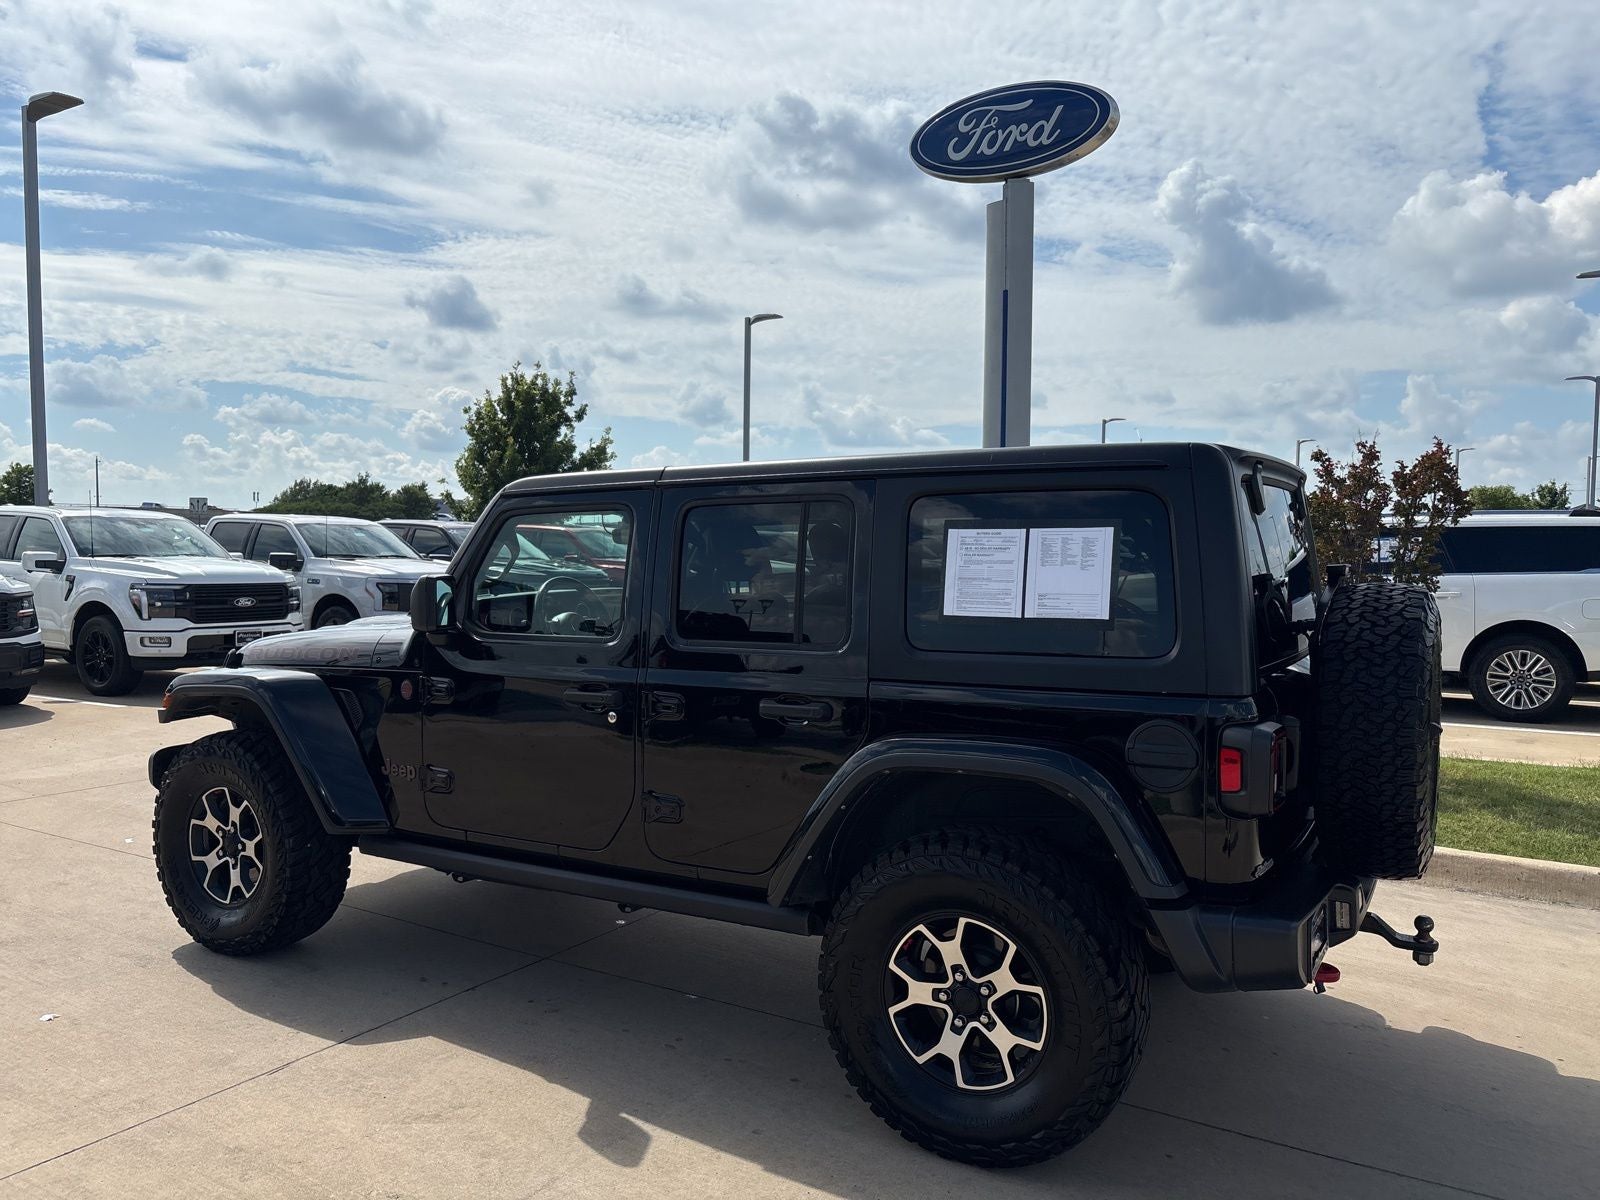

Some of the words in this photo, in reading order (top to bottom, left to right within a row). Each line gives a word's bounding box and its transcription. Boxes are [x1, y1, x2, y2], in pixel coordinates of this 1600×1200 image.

[947, 98, 1064, 161] Ford
[250, 646, 360, 661] RUBICON
[381, 757, 416, 781] Jeep
